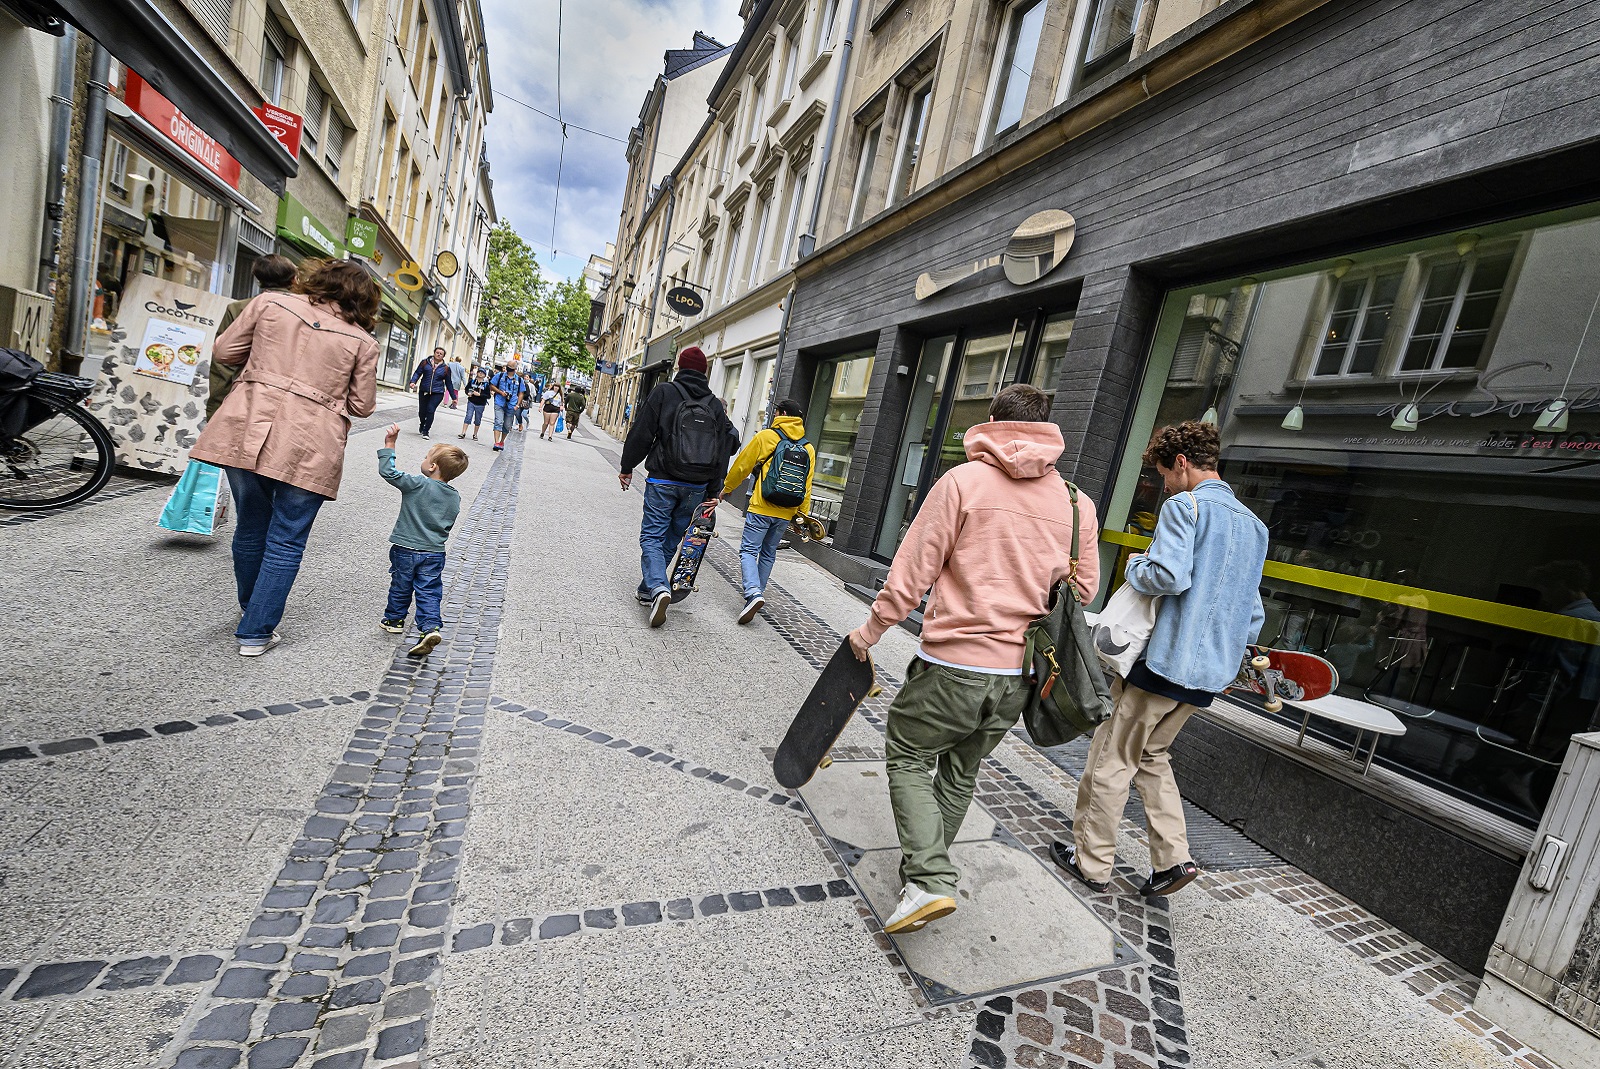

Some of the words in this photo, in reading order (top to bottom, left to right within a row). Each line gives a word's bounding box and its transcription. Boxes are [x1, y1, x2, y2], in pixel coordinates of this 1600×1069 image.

[265, 112, 298, 129] ORIGINALE
[170, 115, 221, 171] ORIGINALE
[675, 293, 694, 307] LPO
[1342, 436, 1363, 444] avec
[1382, 435, 1428, 446] sandwich
[1449, 439, 1470, 447] une
[1521, 436, 1554, 449] c'est
